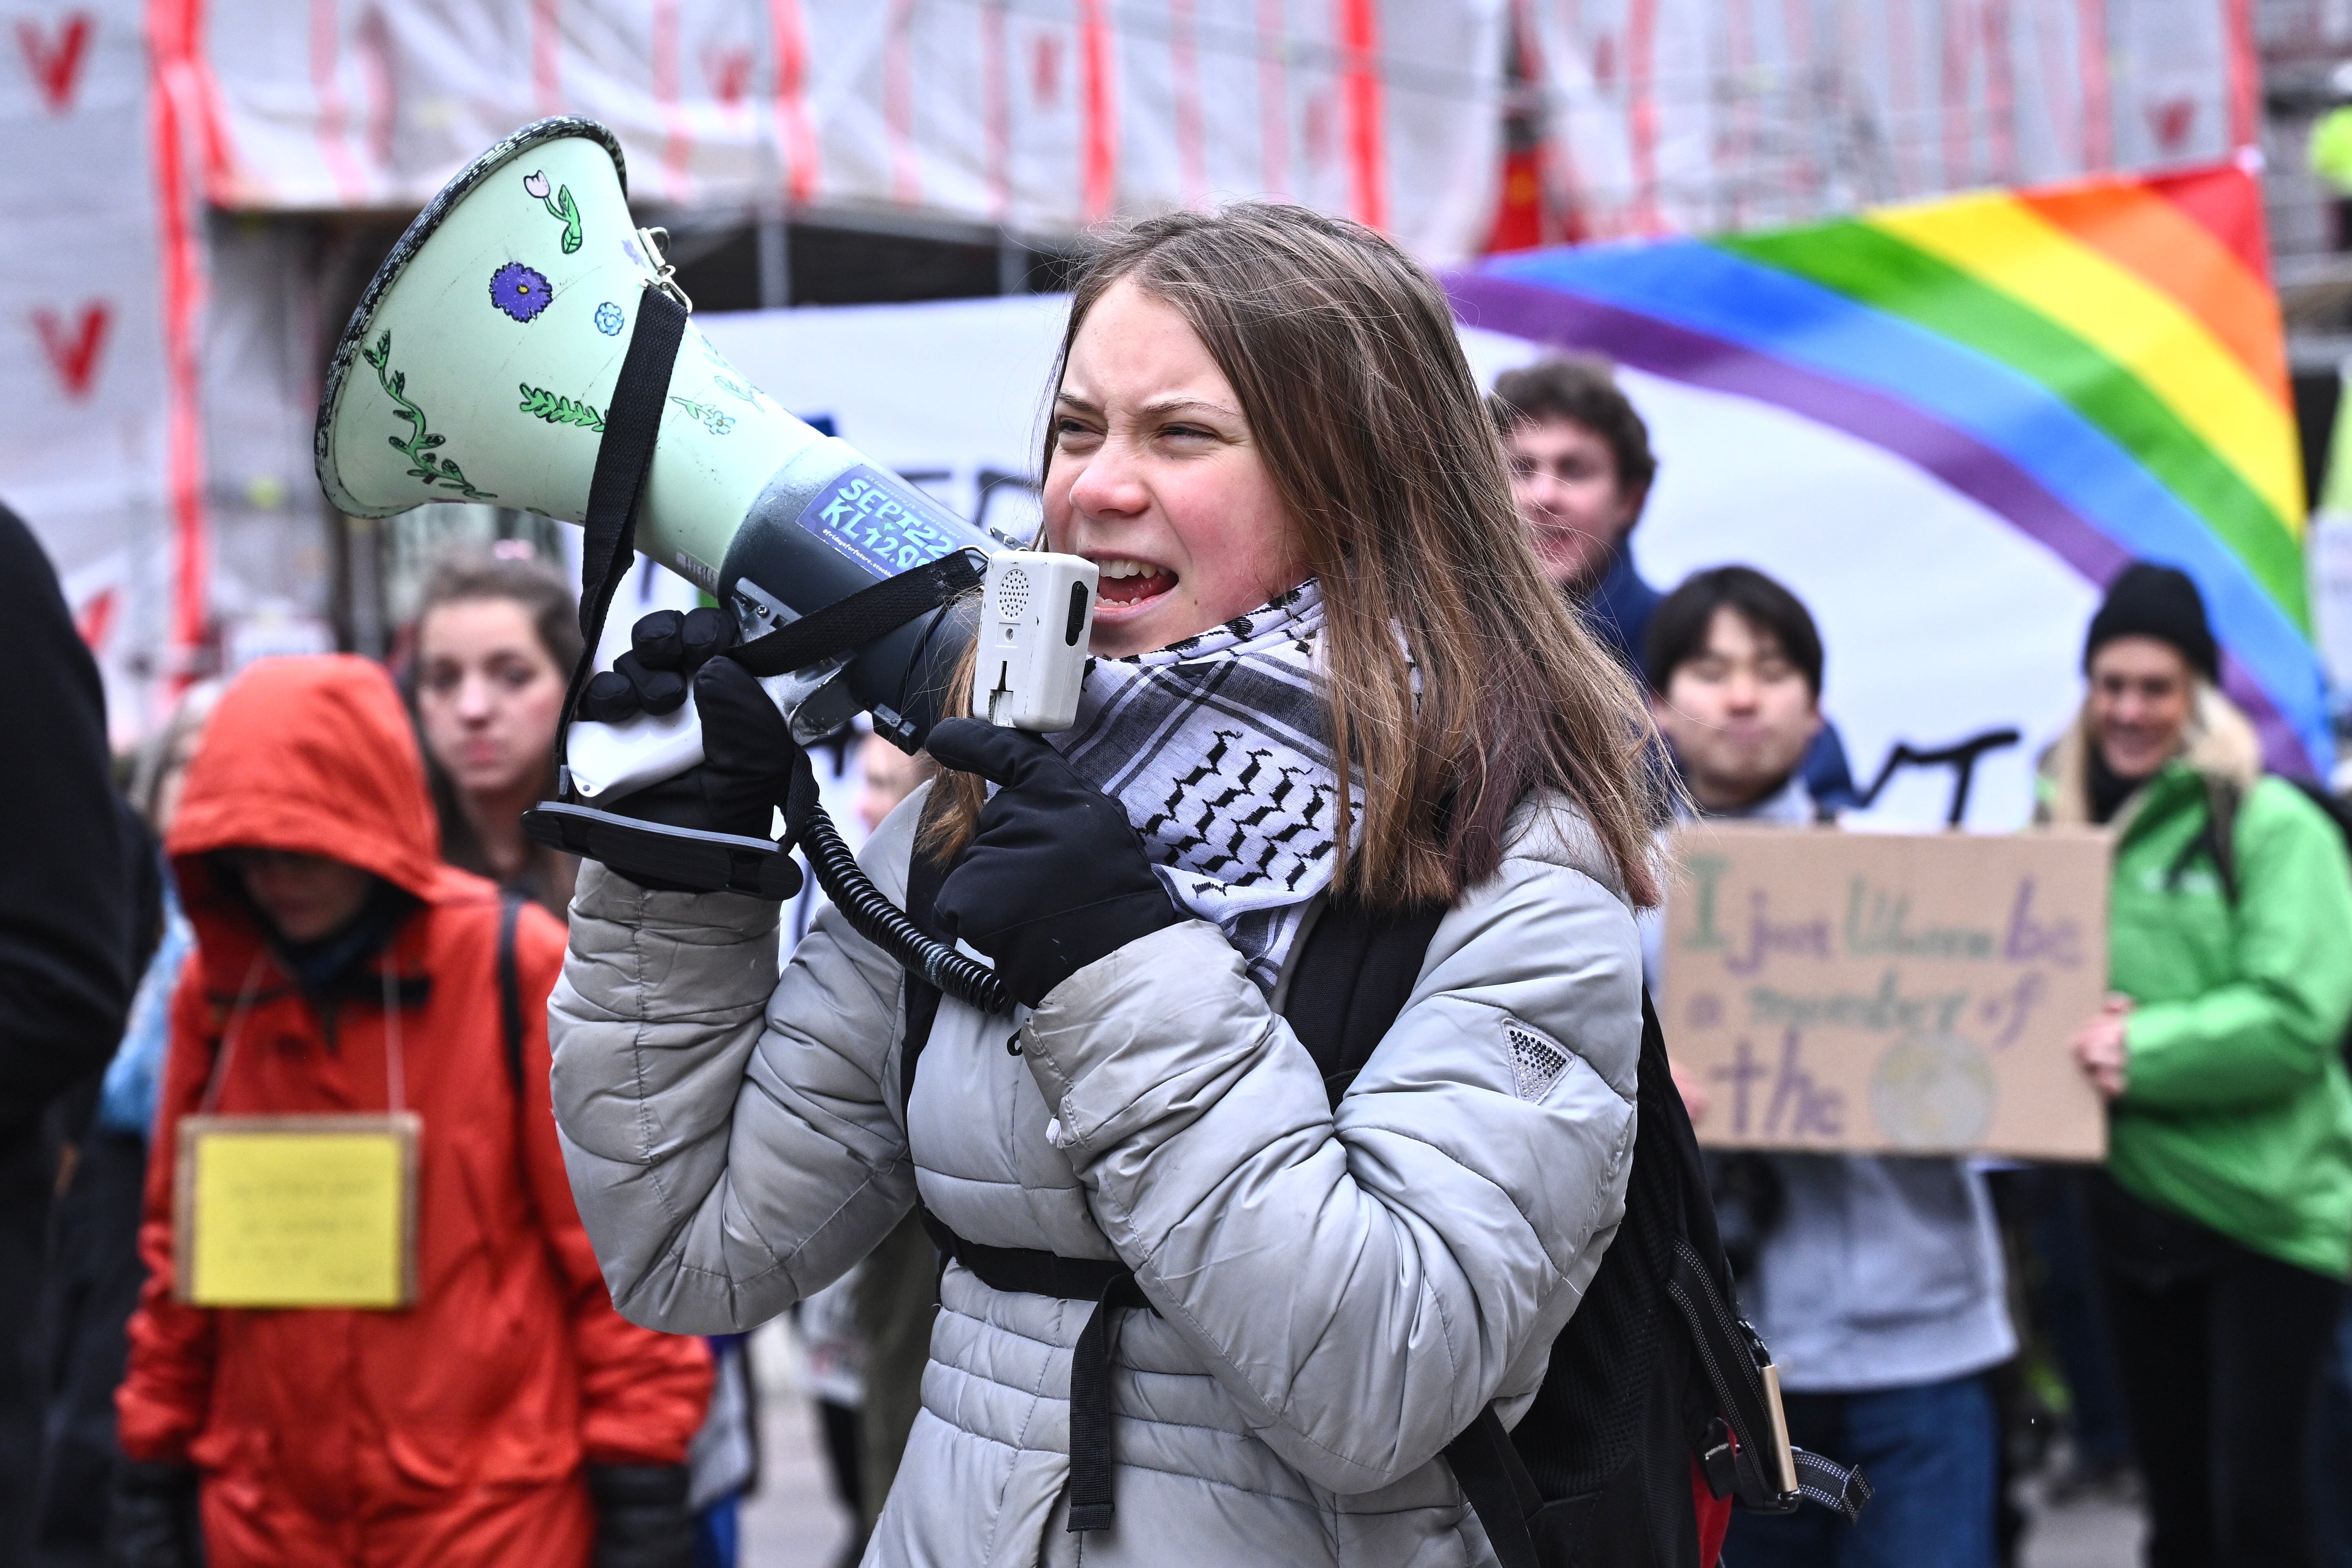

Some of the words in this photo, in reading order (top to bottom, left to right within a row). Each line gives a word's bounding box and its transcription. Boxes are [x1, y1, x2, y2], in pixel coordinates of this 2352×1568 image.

[1683, 854, 1731, 950] I
[2004, 873, 2084, 971] be
[1708, 1021, 1843, 1138] the
